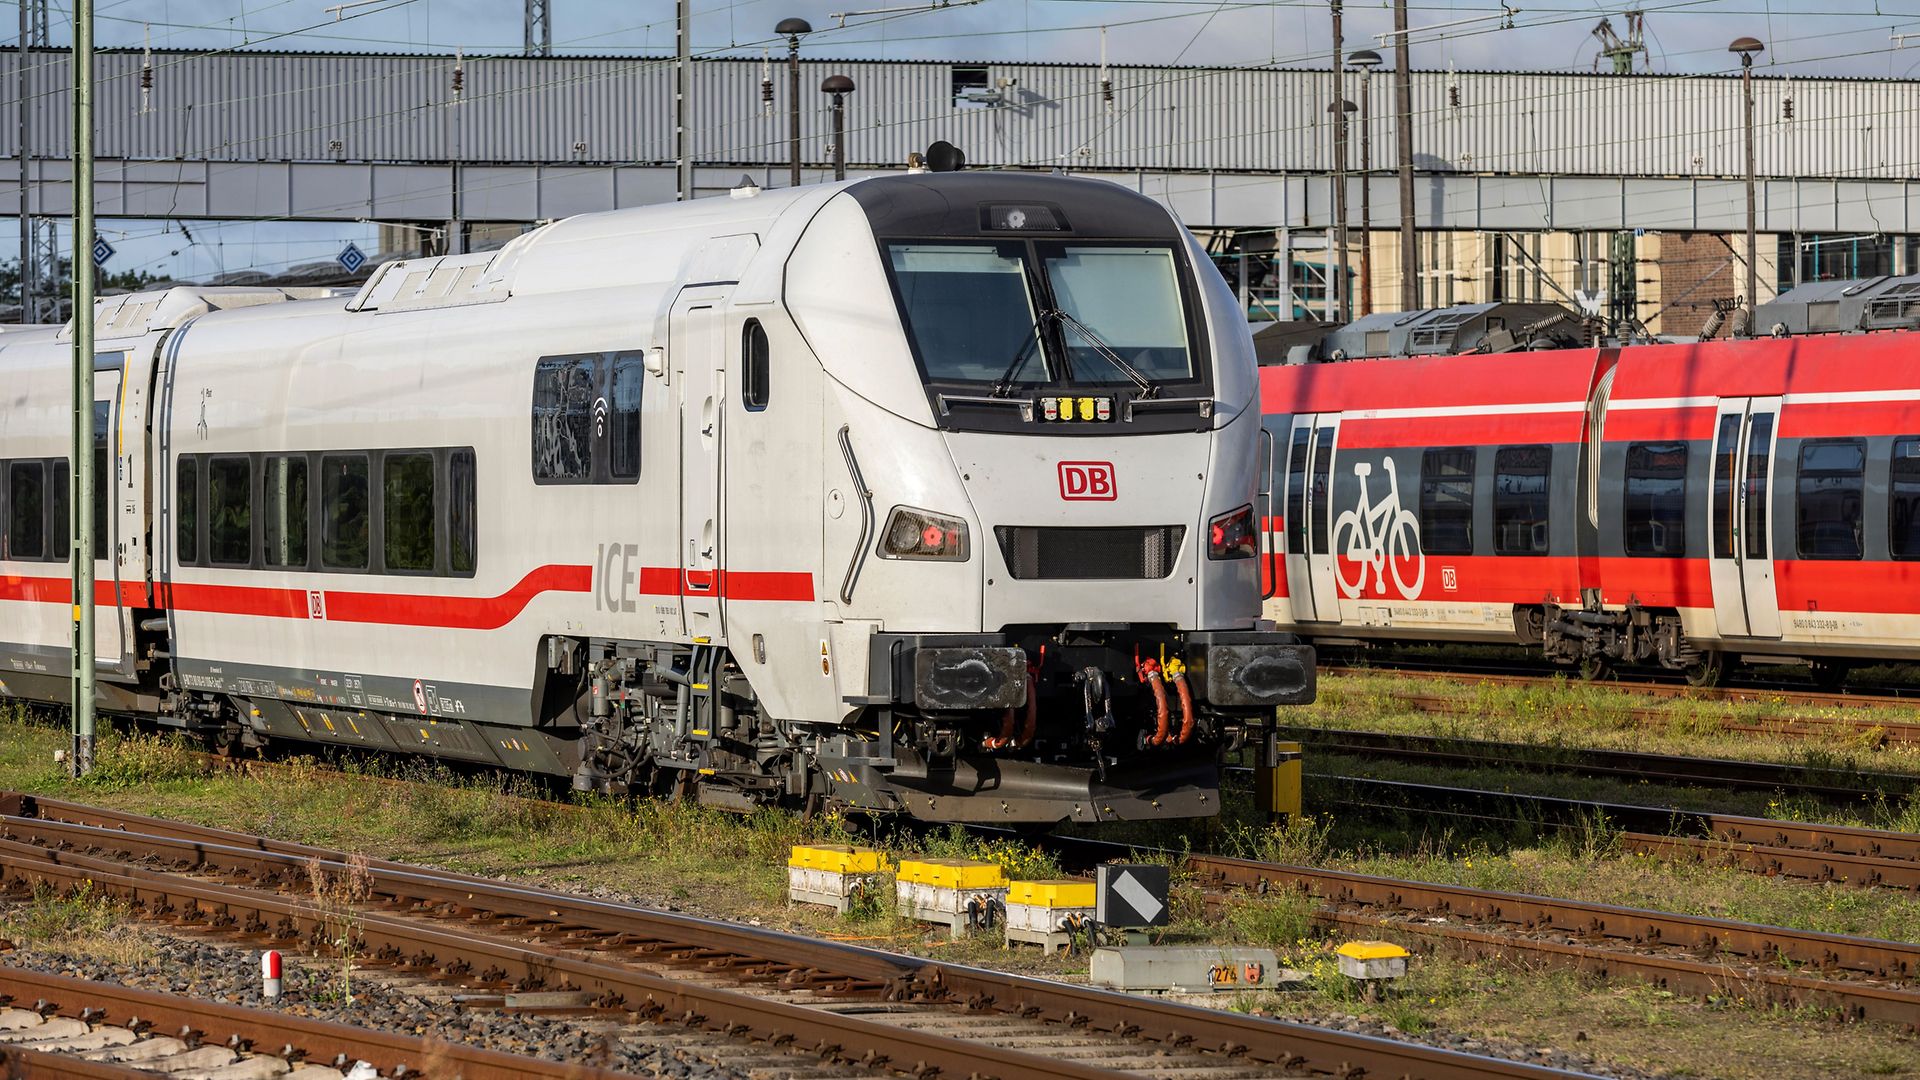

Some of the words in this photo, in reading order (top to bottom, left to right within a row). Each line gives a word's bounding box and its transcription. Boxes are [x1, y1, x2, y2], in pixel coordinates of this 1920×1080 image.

[574, 142, 586, 151] 40
[1064, 466, 1111, 495] DB
[595, 542, 639, 613] ICE
[1443, 570, 1456, 587] DB
[312, 594, 322, 615] DB
[1215, 966, 1238, 984] 274
